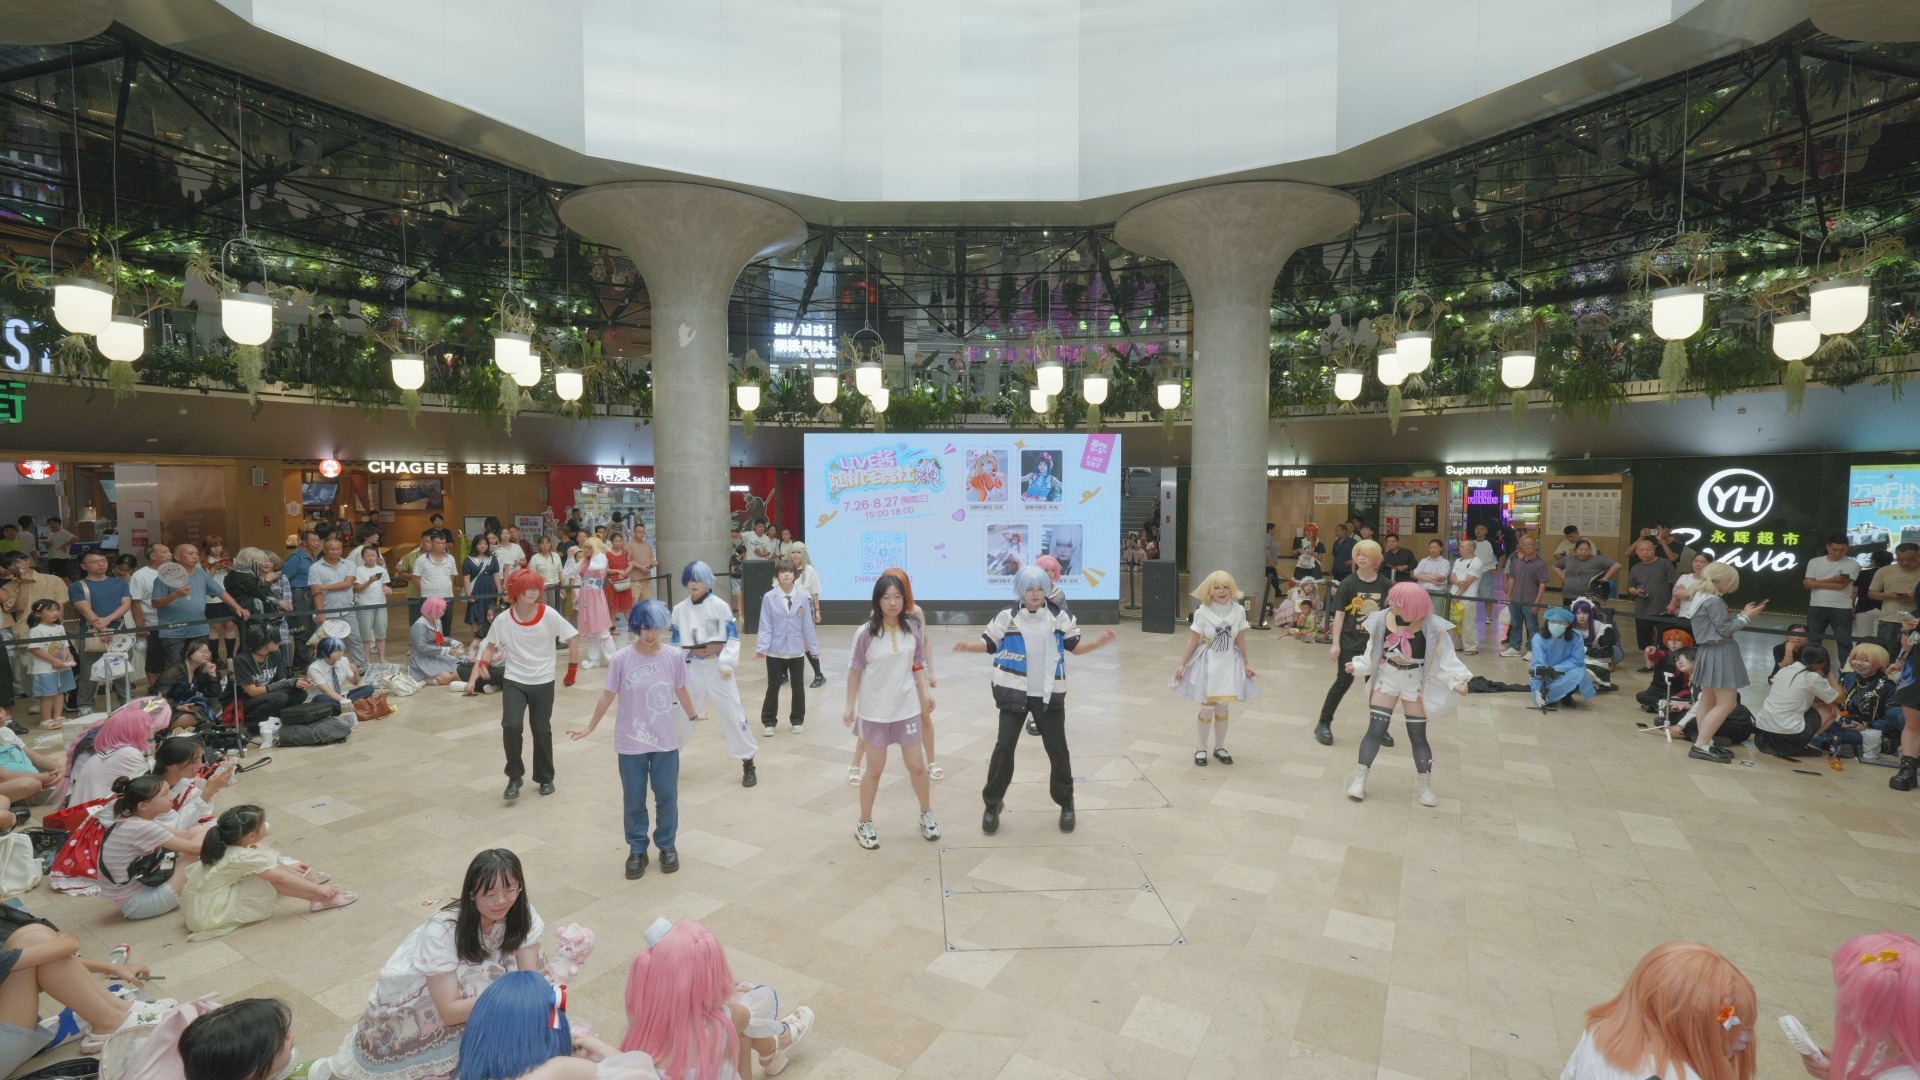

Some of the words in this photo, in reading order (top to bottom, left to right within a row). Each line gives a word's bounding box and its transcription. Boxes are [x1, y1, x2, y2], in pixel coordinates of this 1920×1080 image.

[368, 461, 449, 474] CHAGEE
[466, 463, 526, 475] 霸王茶姬
[1446, 465, 1511, 475] Supermarket
[1516, 466, 1547, 474] 超市入口
[1473, 489, 1493, 497] BEST
[843, 496, 899, 512] 7.26-8.27
[1468, 496, 1499, 505] FRIENDS
[1712, 485, 1766, 514] YH
[865, 507, 915, 519] 15:00-18:00
[1710, 529, 1800, 546] 永辉超市
[635, 729, 659, 745] TOYA
